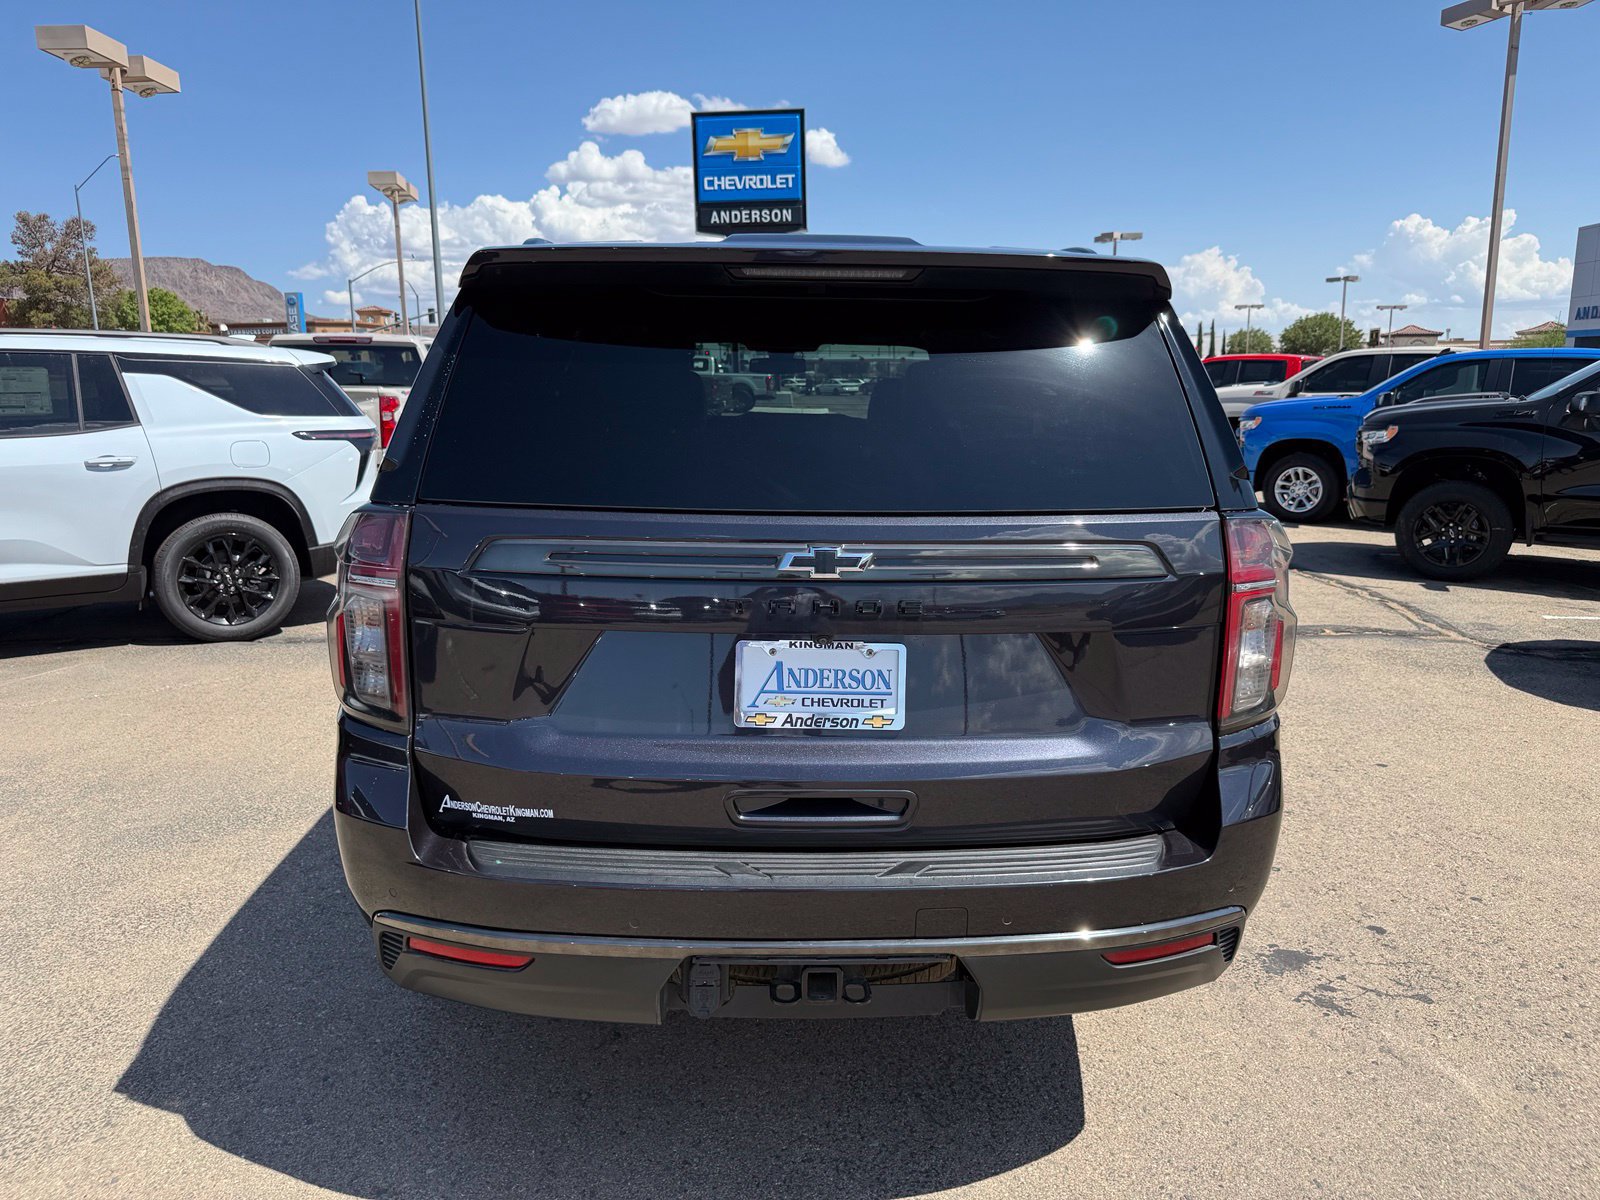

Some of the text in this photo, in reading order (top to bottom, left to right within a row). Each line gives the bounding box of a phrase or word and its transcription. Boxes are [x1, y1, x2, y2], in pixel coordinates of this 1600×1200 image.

[704, 174, 795, 190] CHEVROLET
[711, 208, 792, 224] ANDERSON
[1574, 305, 1600, 321] AND
[788, 641, 854, 650] KINGMAN
[747, 660, 893, 708] ANDERSON
[801, 697, 887, 709] CHEVROLET
[781, 713, 859, 729] Anderson
[472, 812, 505, 822] KINGMAN,
